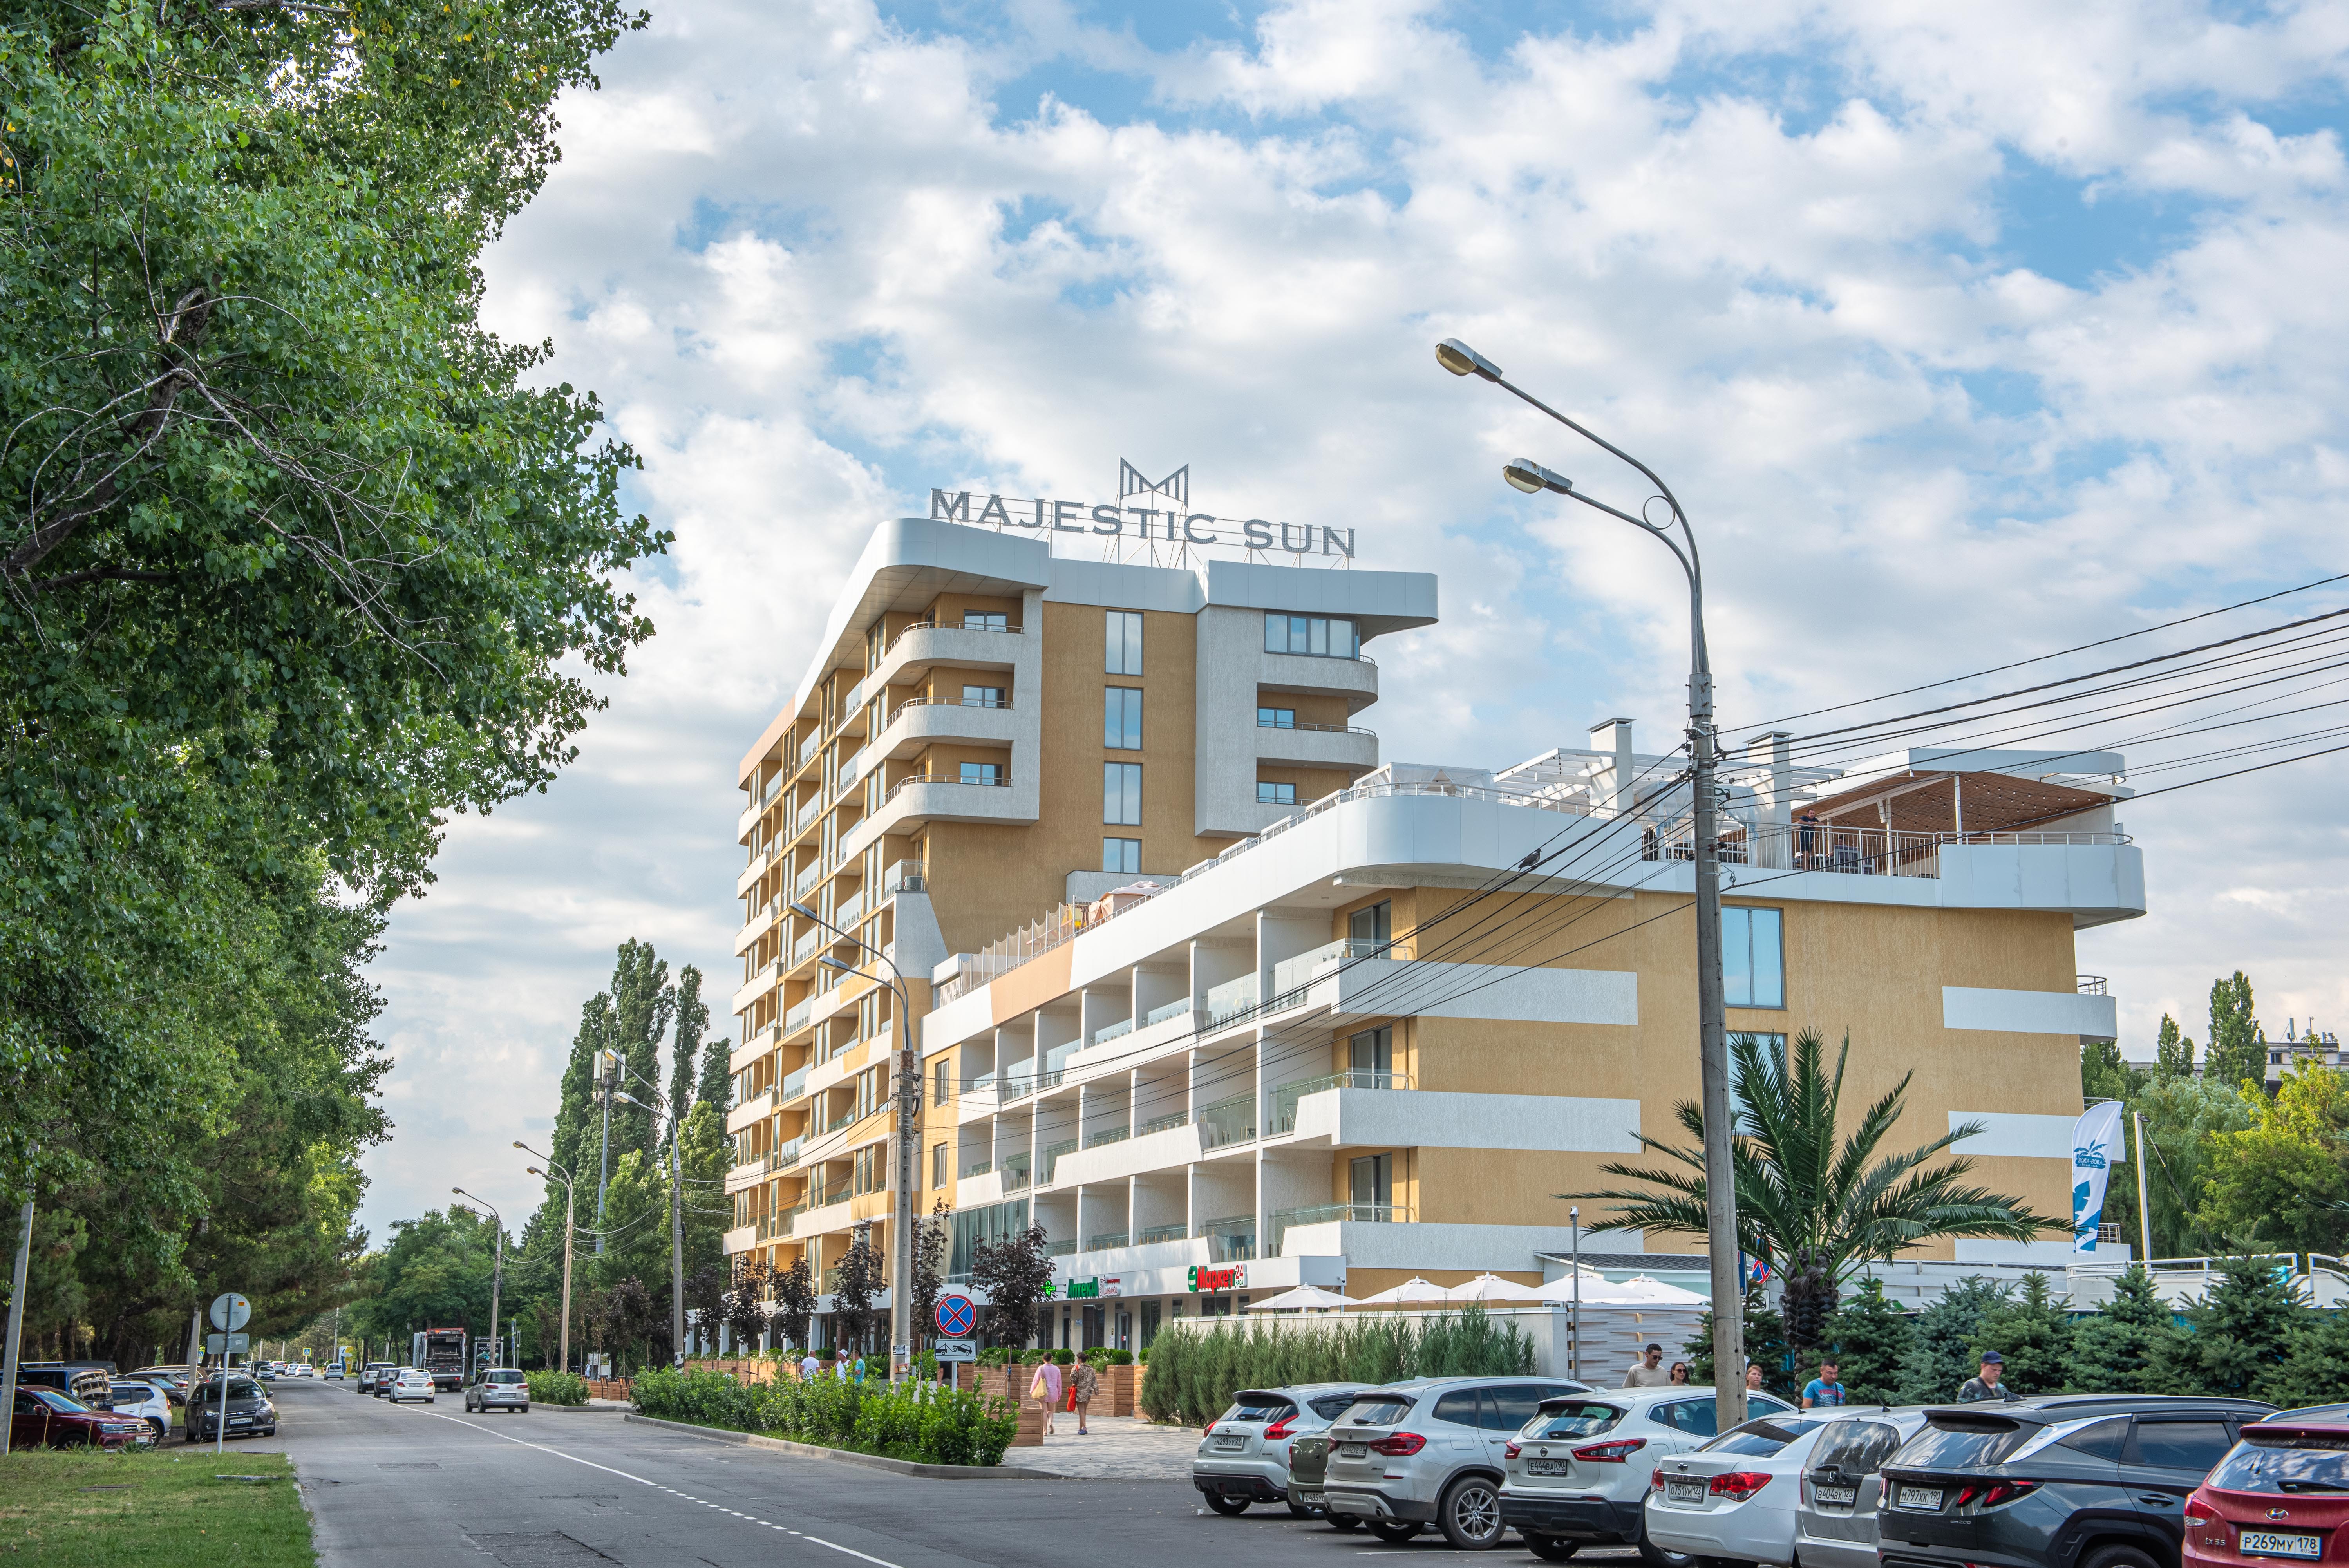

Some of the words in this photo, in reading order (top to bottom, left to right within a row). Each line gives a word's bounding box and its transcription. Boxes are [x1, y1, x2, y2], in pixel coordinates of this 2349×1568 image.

[931, 488, 1217, 544] MAJESTIC
[1243, 519, 1355, 558] SUN
[1235, 1265, 1243, 1279] 24
[1197, 1266, 1235, 1295] Маркет
[1343, 1445, 1359, 1454] О442ХВ
[1530, 1461, 1554, 1471] Е444ВА
[1671, 1485, 1692, 1496] О751УМ
[1693, 1486, 1701, 1495] 123
[1818, 1488, 1842, 1500] В404ВХ
[1844, 1489, 1853, 1497] 123
[1901, 1489, 1928, 1503] М797ХК
[1930, 1490, 1940, 1500] 190
[2244, 1534, 2294, 1551] Р269МУ
[2297, 1537, 2316, 1549] 178
